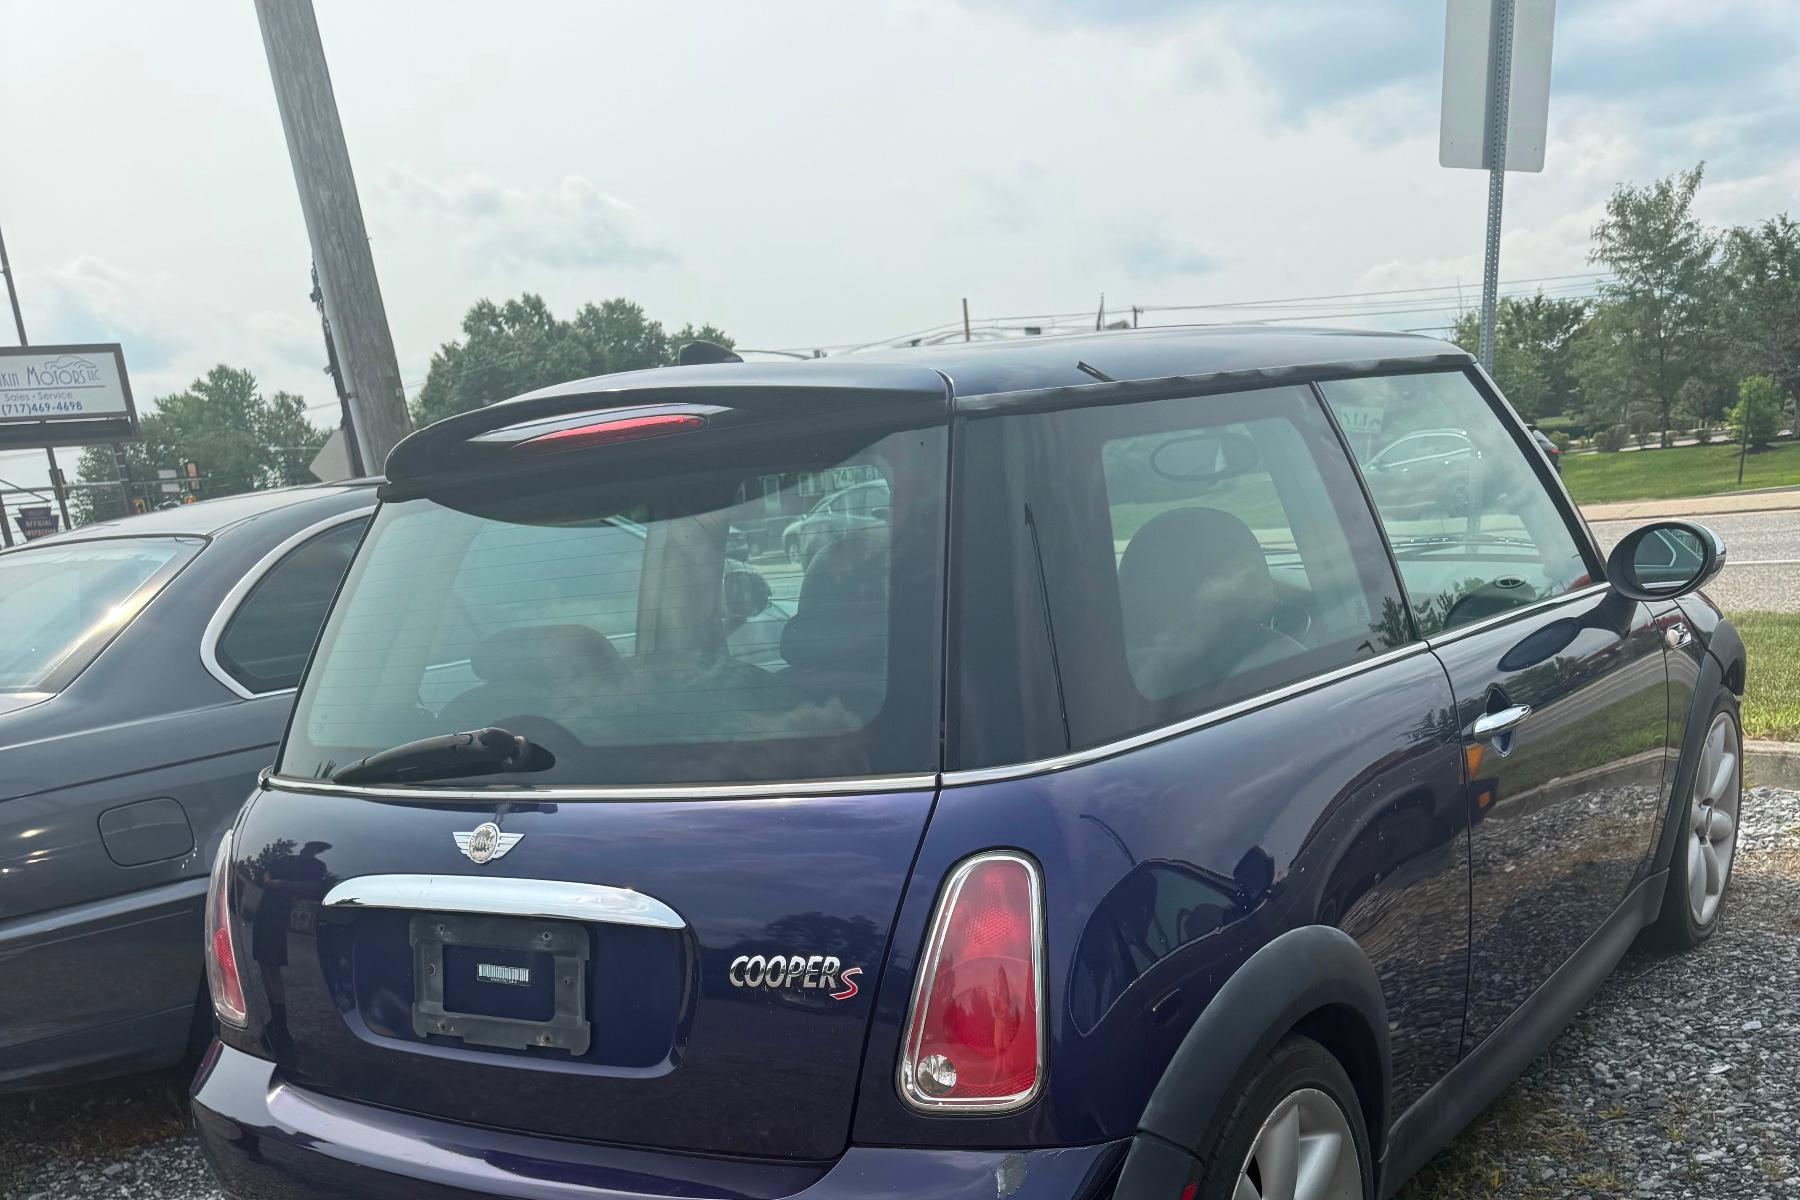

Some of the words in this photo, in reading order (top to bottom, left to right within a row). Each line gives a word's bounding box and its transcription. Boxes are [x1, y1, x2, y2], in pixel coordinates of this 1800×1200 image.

[4, 392, 30, 402] Sales
[38, 391, 73, 401] Service
[1, 401, 83, 416] (717)469-4698
